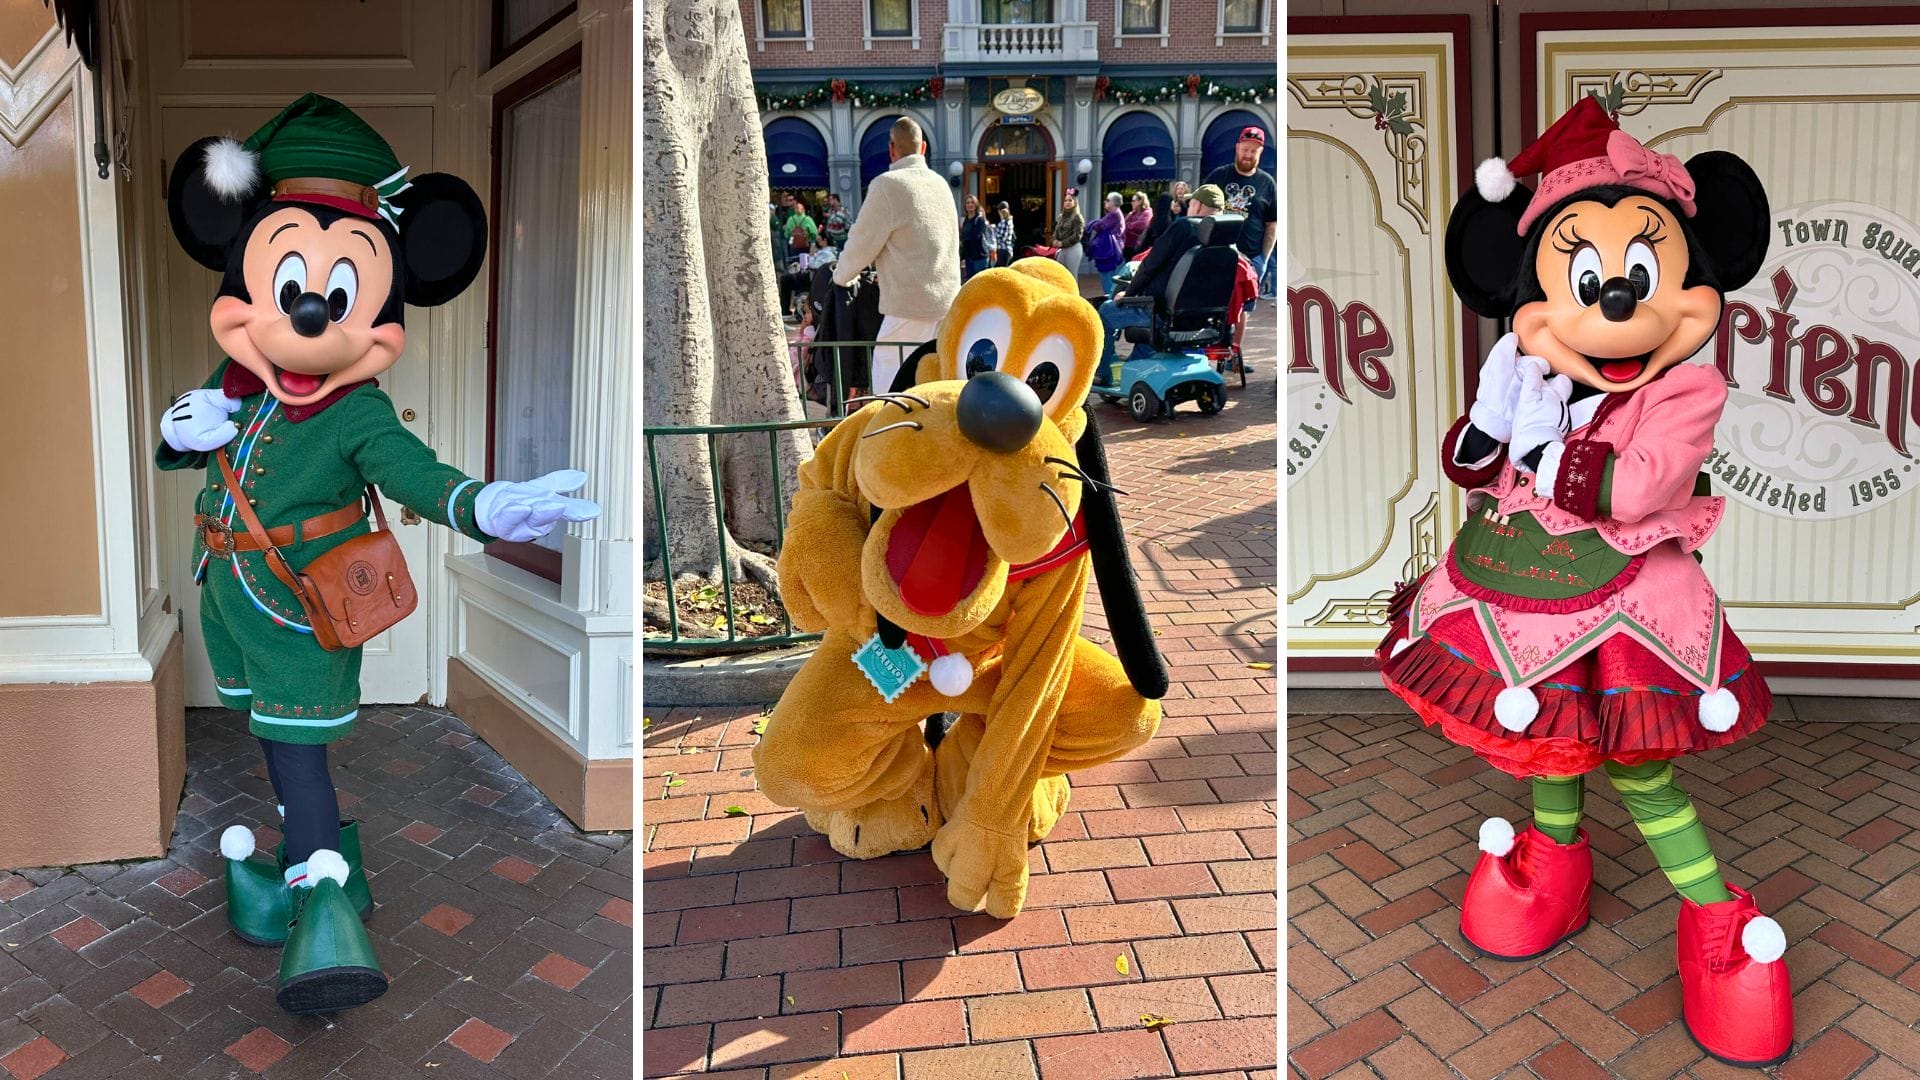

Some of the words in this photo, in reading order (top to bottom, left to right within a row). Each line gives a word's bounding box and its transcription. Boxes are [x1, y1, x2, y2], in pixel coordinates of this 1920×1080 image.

[1778, 219, 1848, 248] Town
[1713, 265, 1920, 455] rien
[1704, 448, 1826, 515] stablished
[1849, 468, 1901, 506] 1955
[874, 645, 903, 679] PLUTO
